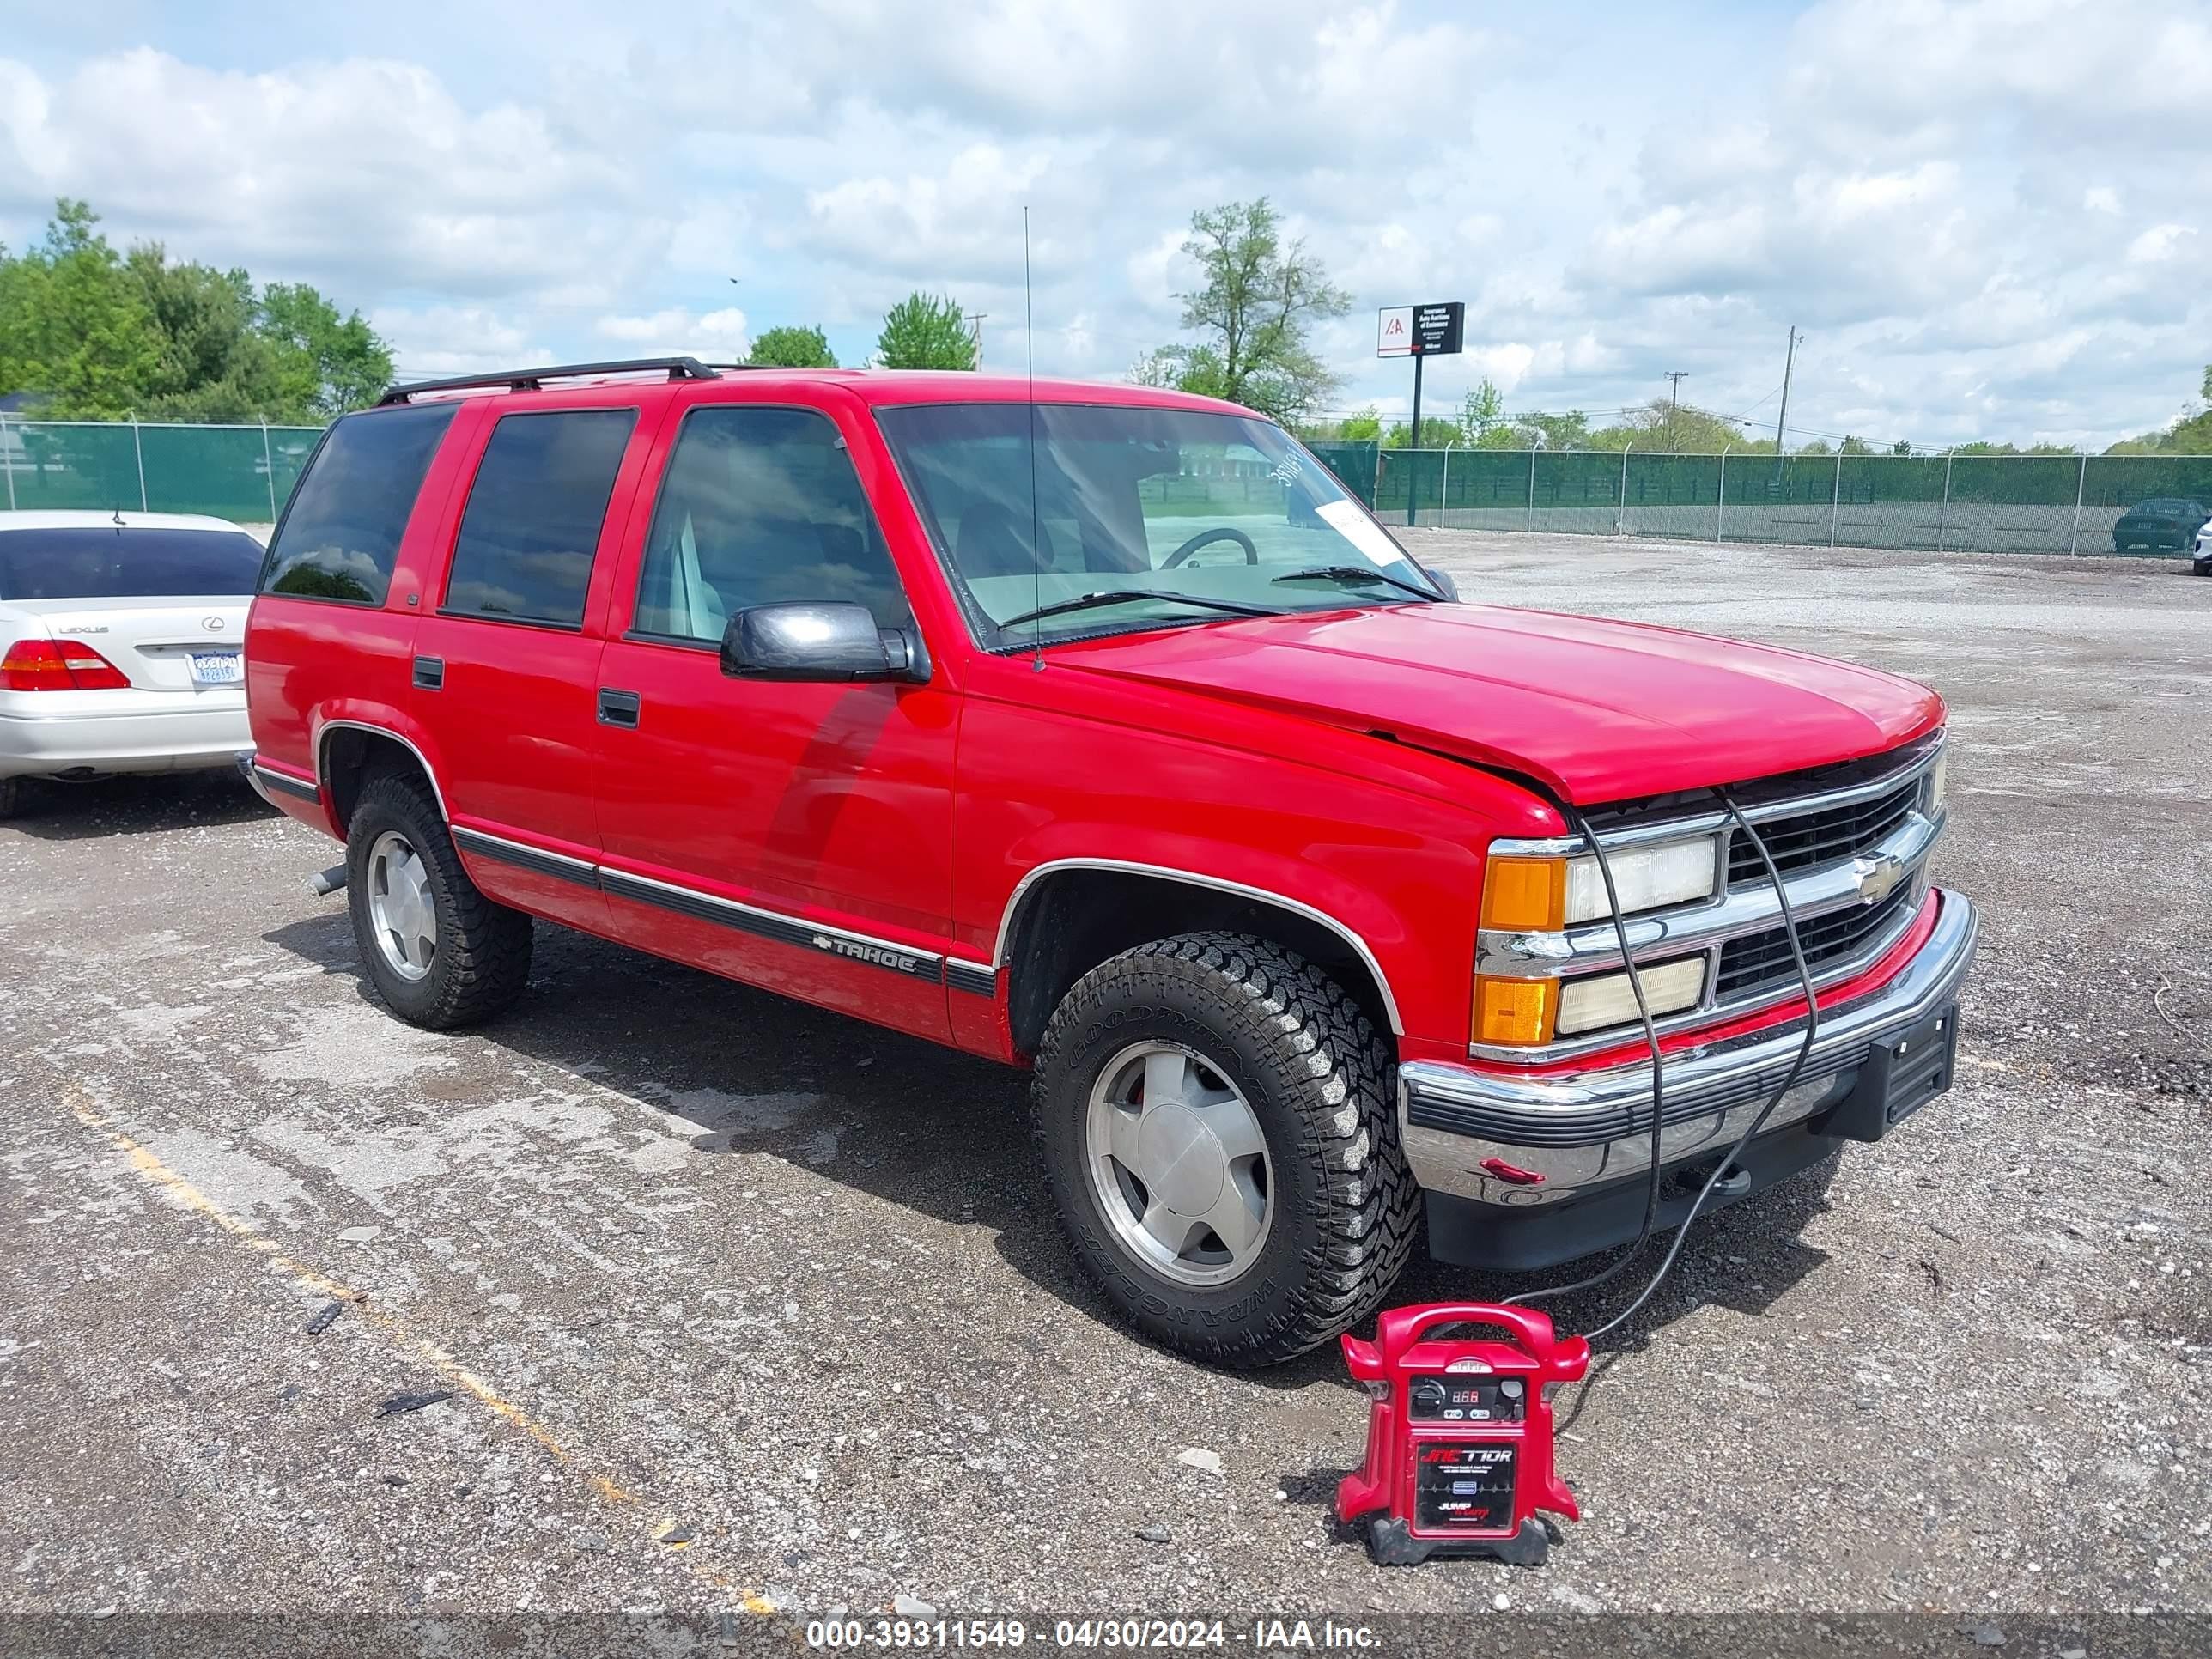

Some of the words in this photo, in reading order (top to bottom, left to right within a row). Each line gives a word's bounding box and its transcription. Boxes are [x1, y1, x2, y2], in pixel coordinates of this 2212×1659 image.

[58, 626, 109, 635] LEXUS
[833, 939, 917, 974] TAHOE
[1079, 1223, 1278, 1327] WRANGLER
[1437, 1502, 1472, 1510] JUMP
